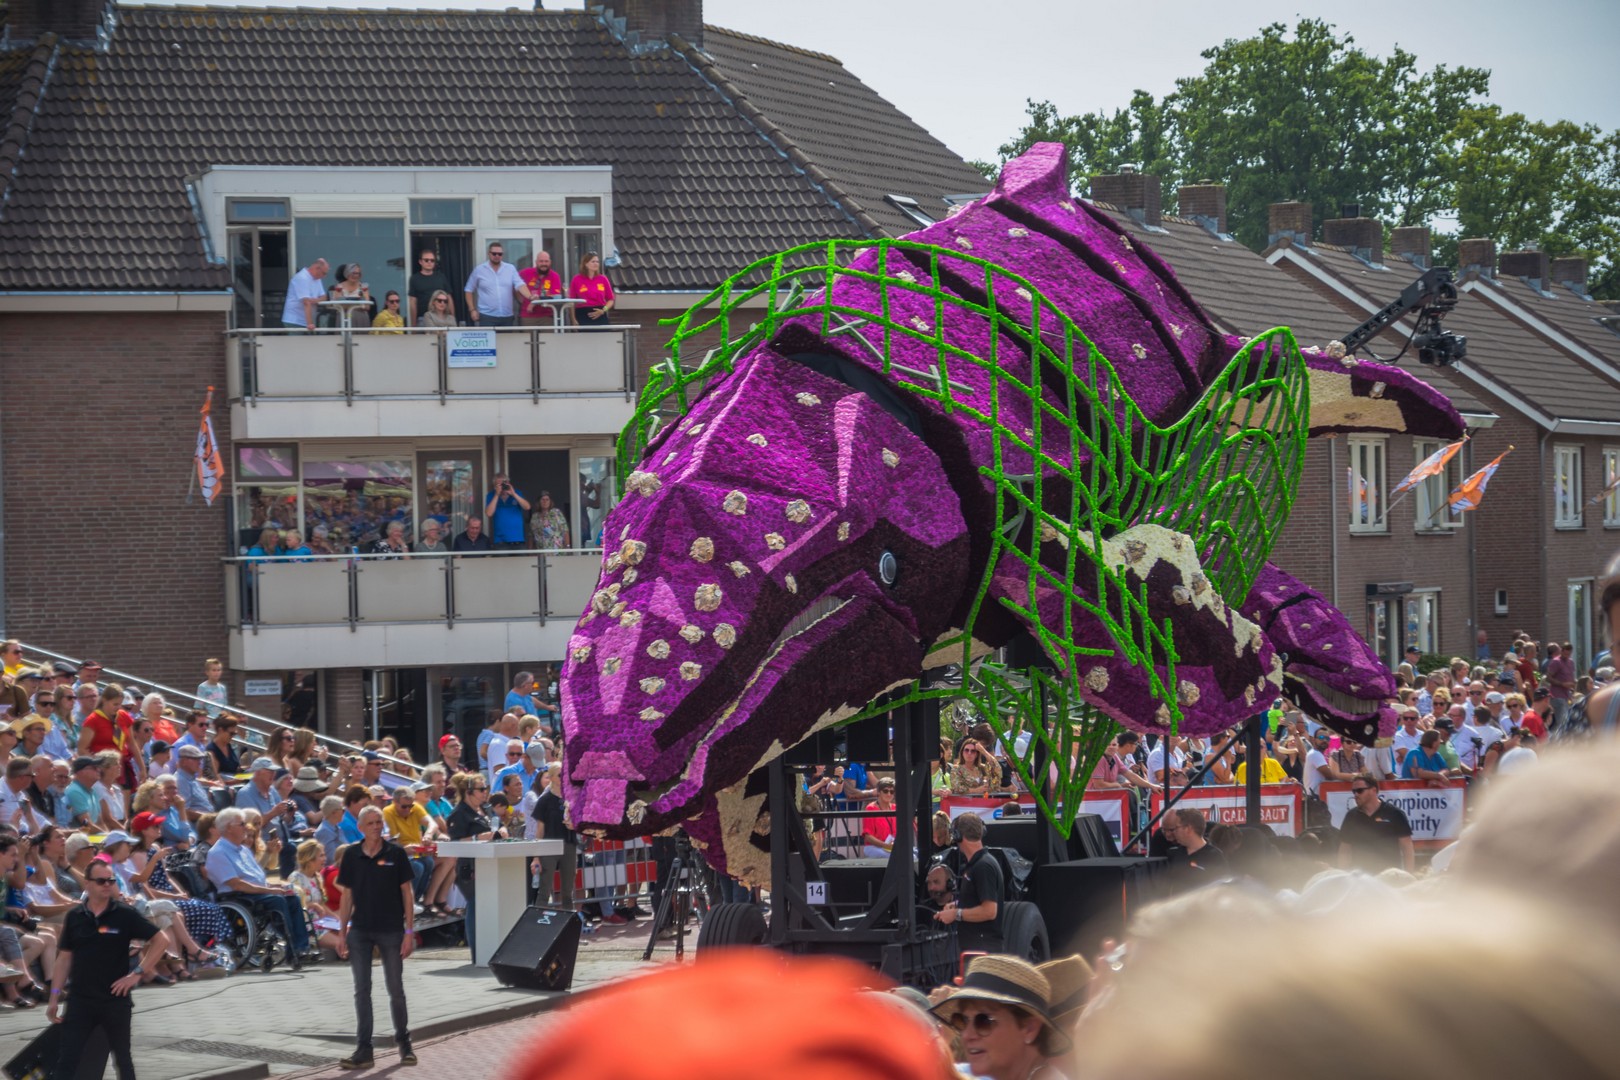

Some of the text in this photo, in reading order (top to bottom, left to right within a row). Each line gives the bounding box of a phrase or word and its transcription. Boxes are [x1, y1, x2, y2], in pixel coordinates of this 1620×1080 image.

[454, 338, 489, 348] Volant
[1222, 808, 1287, 822] CALBAUT
[809, 885, 823, 896] 14
